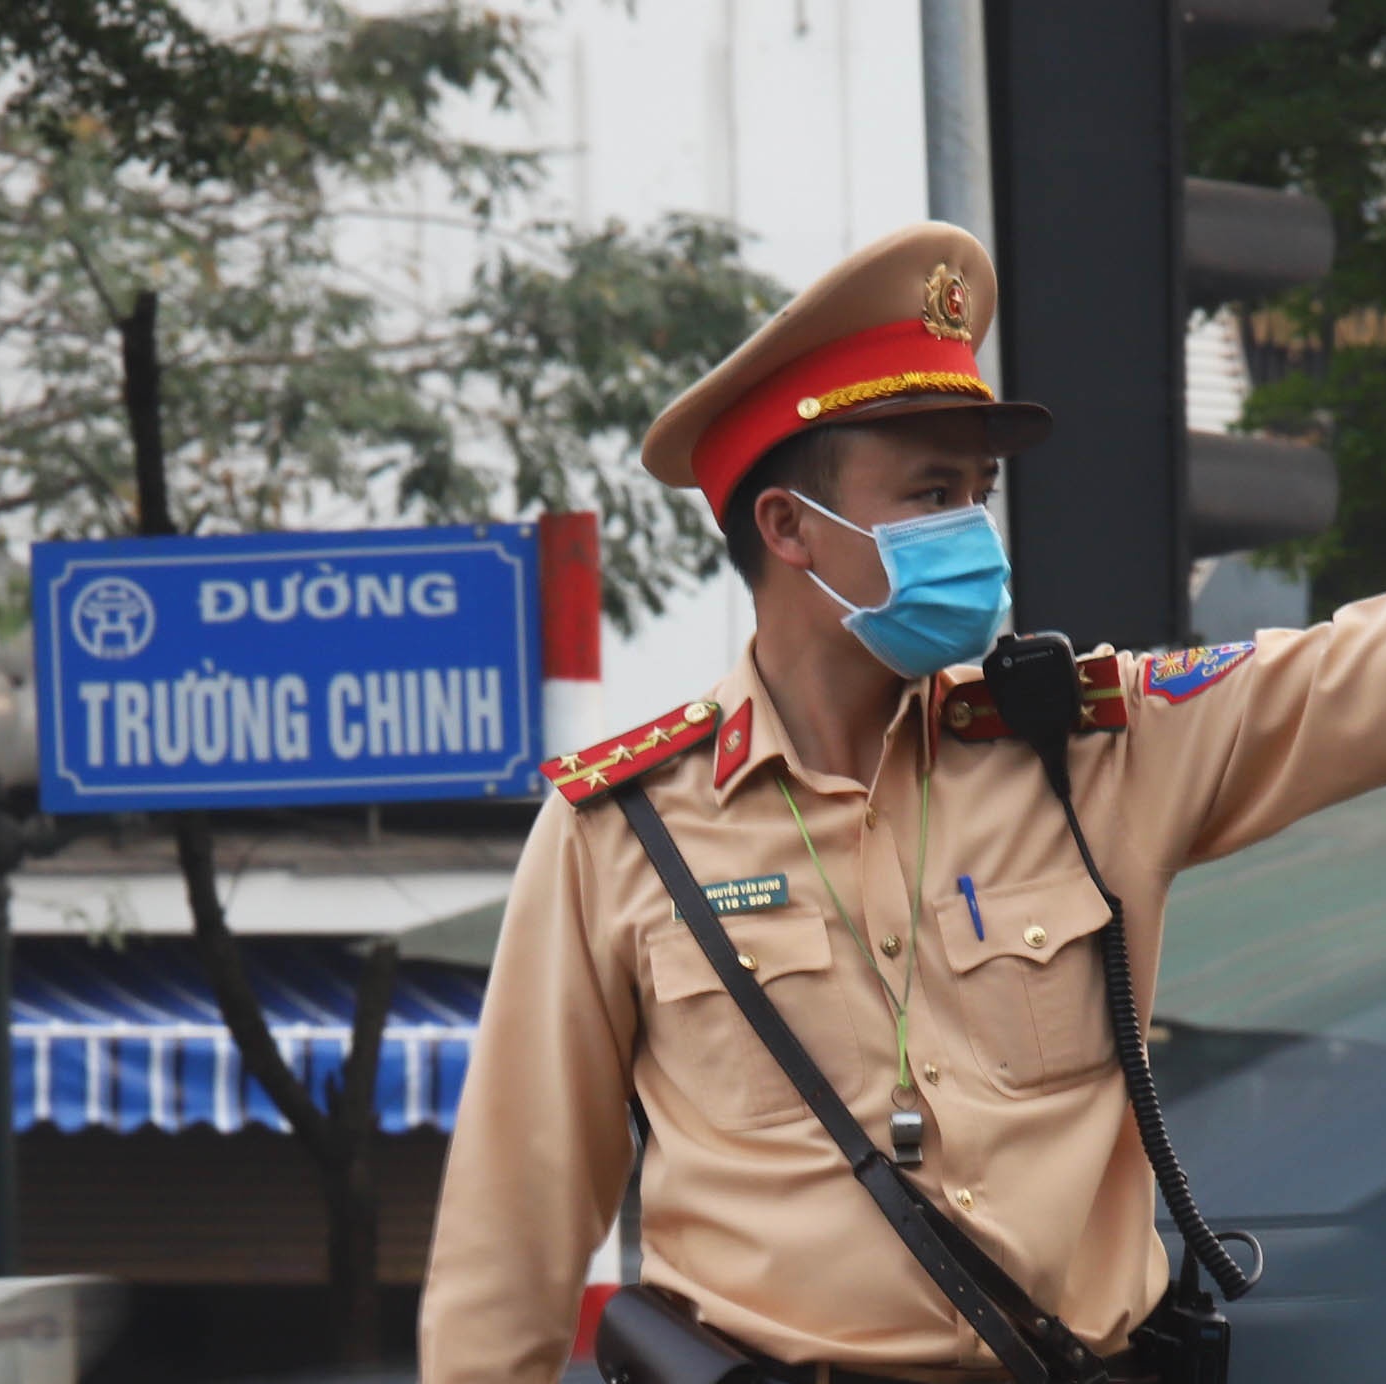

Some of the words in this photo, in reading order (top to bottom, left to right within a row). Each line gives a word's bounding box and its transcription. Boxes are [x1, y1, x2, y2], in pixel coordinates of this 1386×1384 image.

[198, 563, 458, 622] ĐƯỜNG
[79, 658, 309, 766] TRƯỜNG
[328, 668, 504, 760] CHINH
